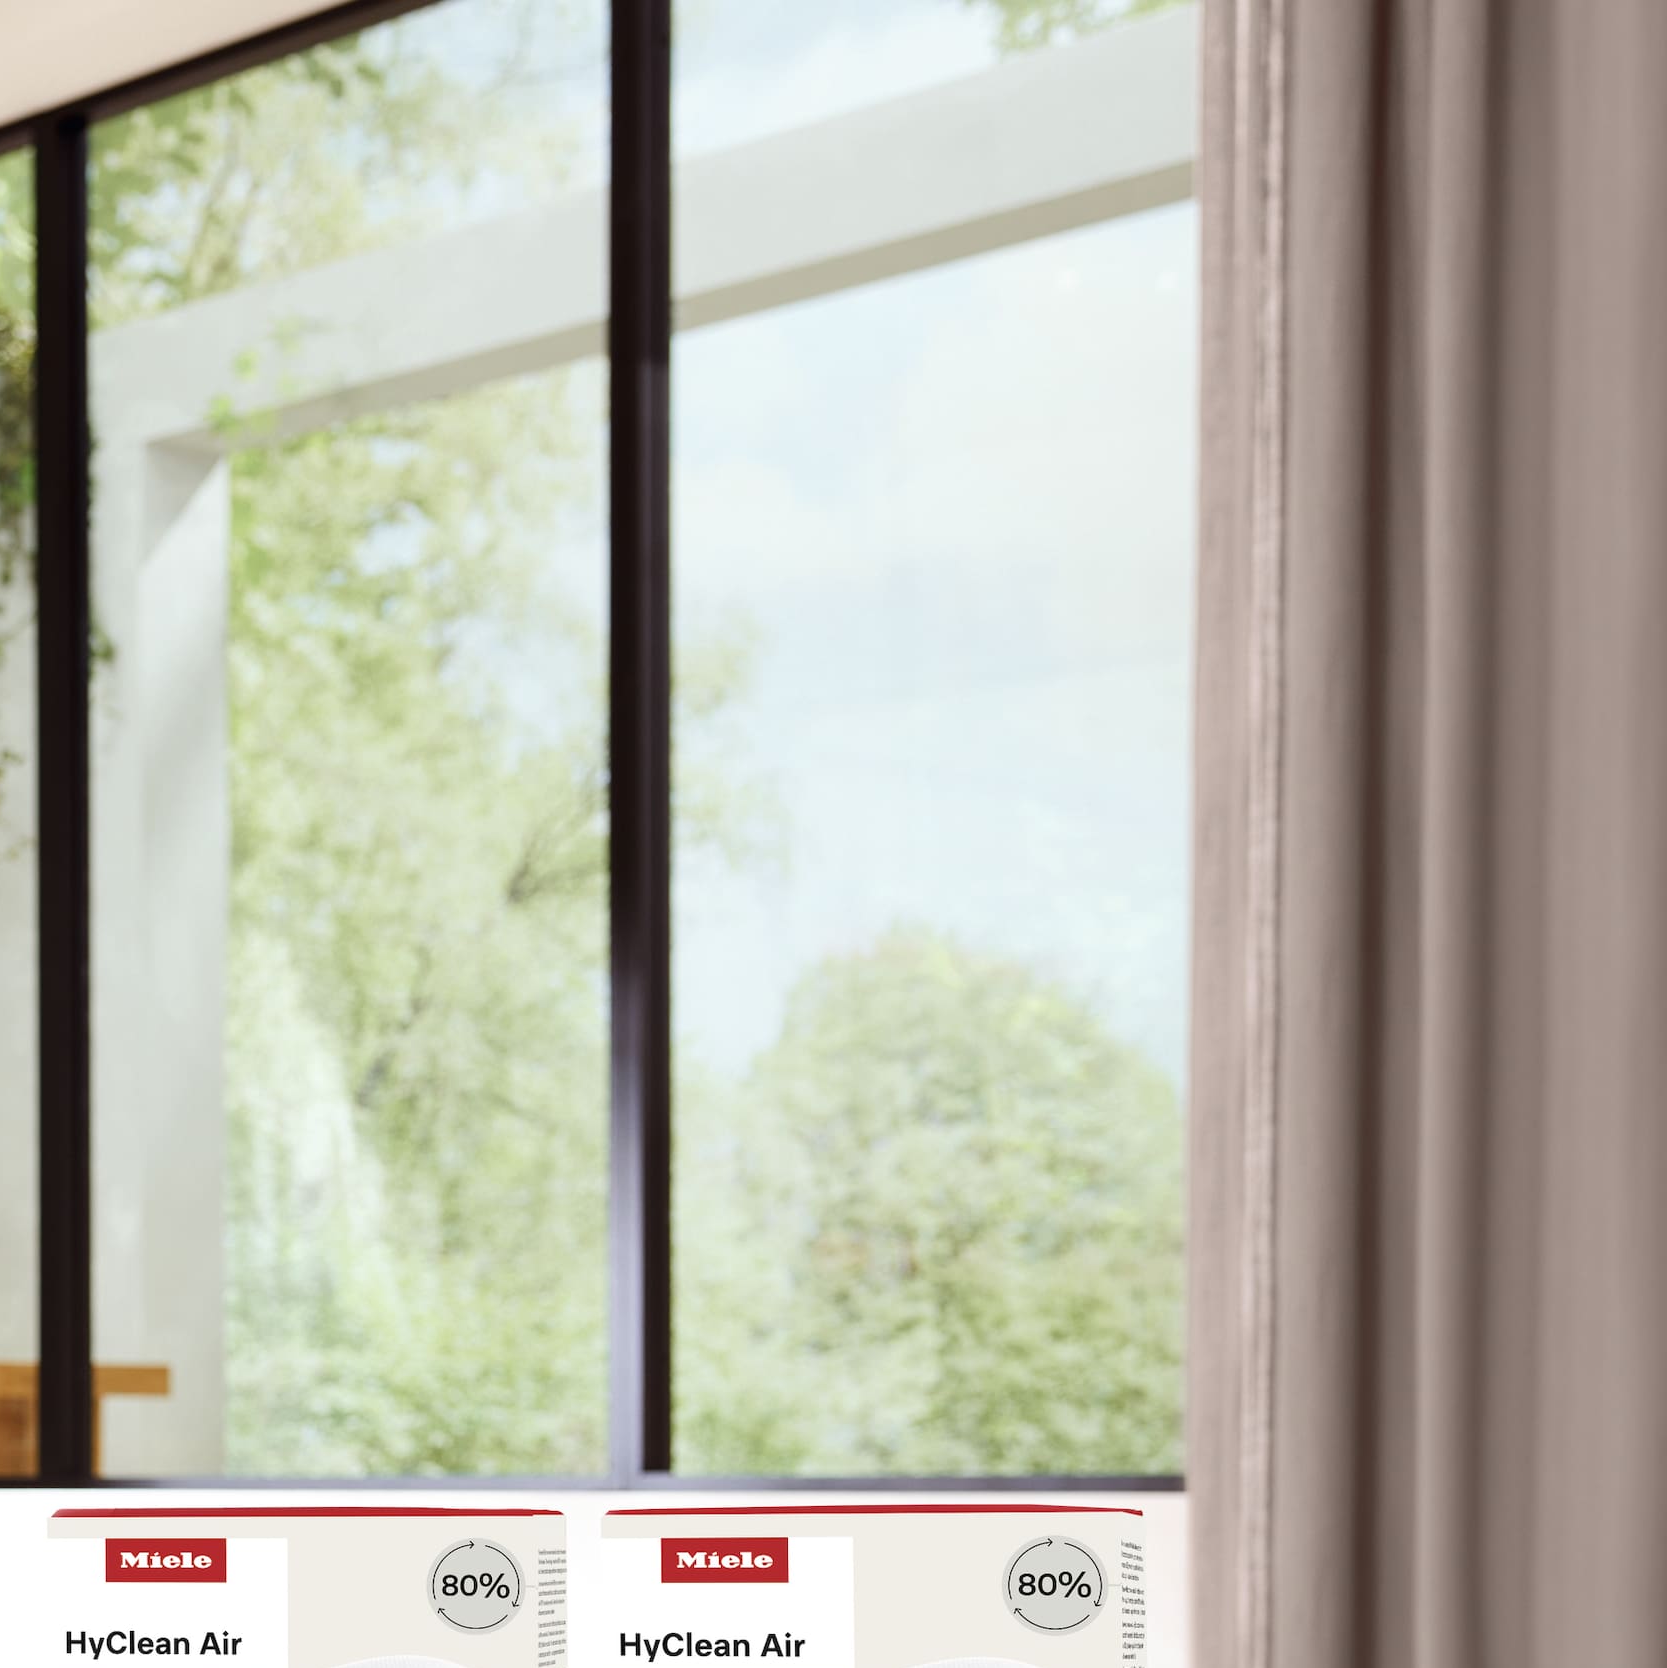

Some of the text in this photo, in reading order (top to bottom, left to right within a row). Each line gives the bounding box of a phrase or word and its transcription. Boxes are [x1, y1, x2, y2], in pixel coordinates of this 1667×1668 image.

[119, 1551, 213, 1569] Miele
[676, 1551, 774, 1569] Miele
[440, 1572, 511, 1599] 80%
[1017, 1572, 1092, 1599] 80%
[65, 1629, 243, 1661] HyClean Air
[619, 1631, 806, 1663] HyClean Air
